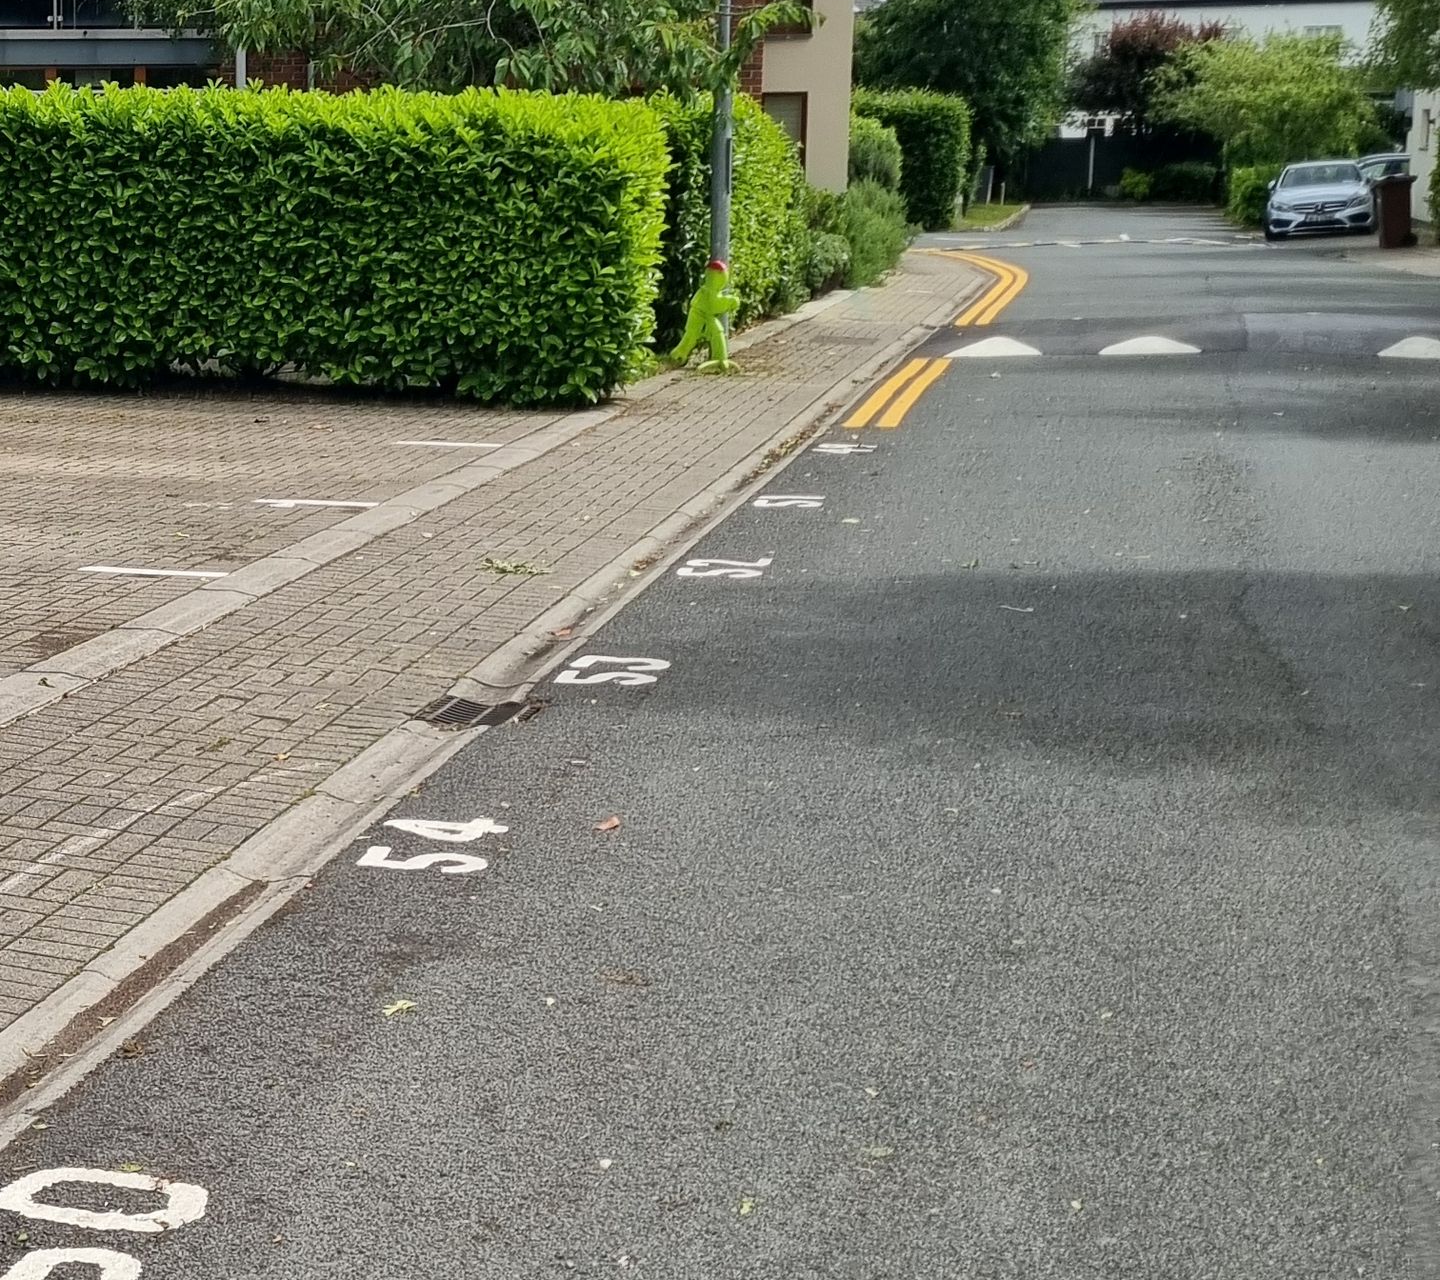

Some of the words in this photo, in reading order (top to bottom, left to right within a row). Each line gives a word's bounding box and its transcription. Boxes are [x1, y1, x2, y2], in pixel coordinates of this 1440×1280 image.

[753, 495, 826, 507] 51
[676, 558, 773, 578] 52
[553, 655, 671, 685] 53
[356, 818, 509, 873] 54
